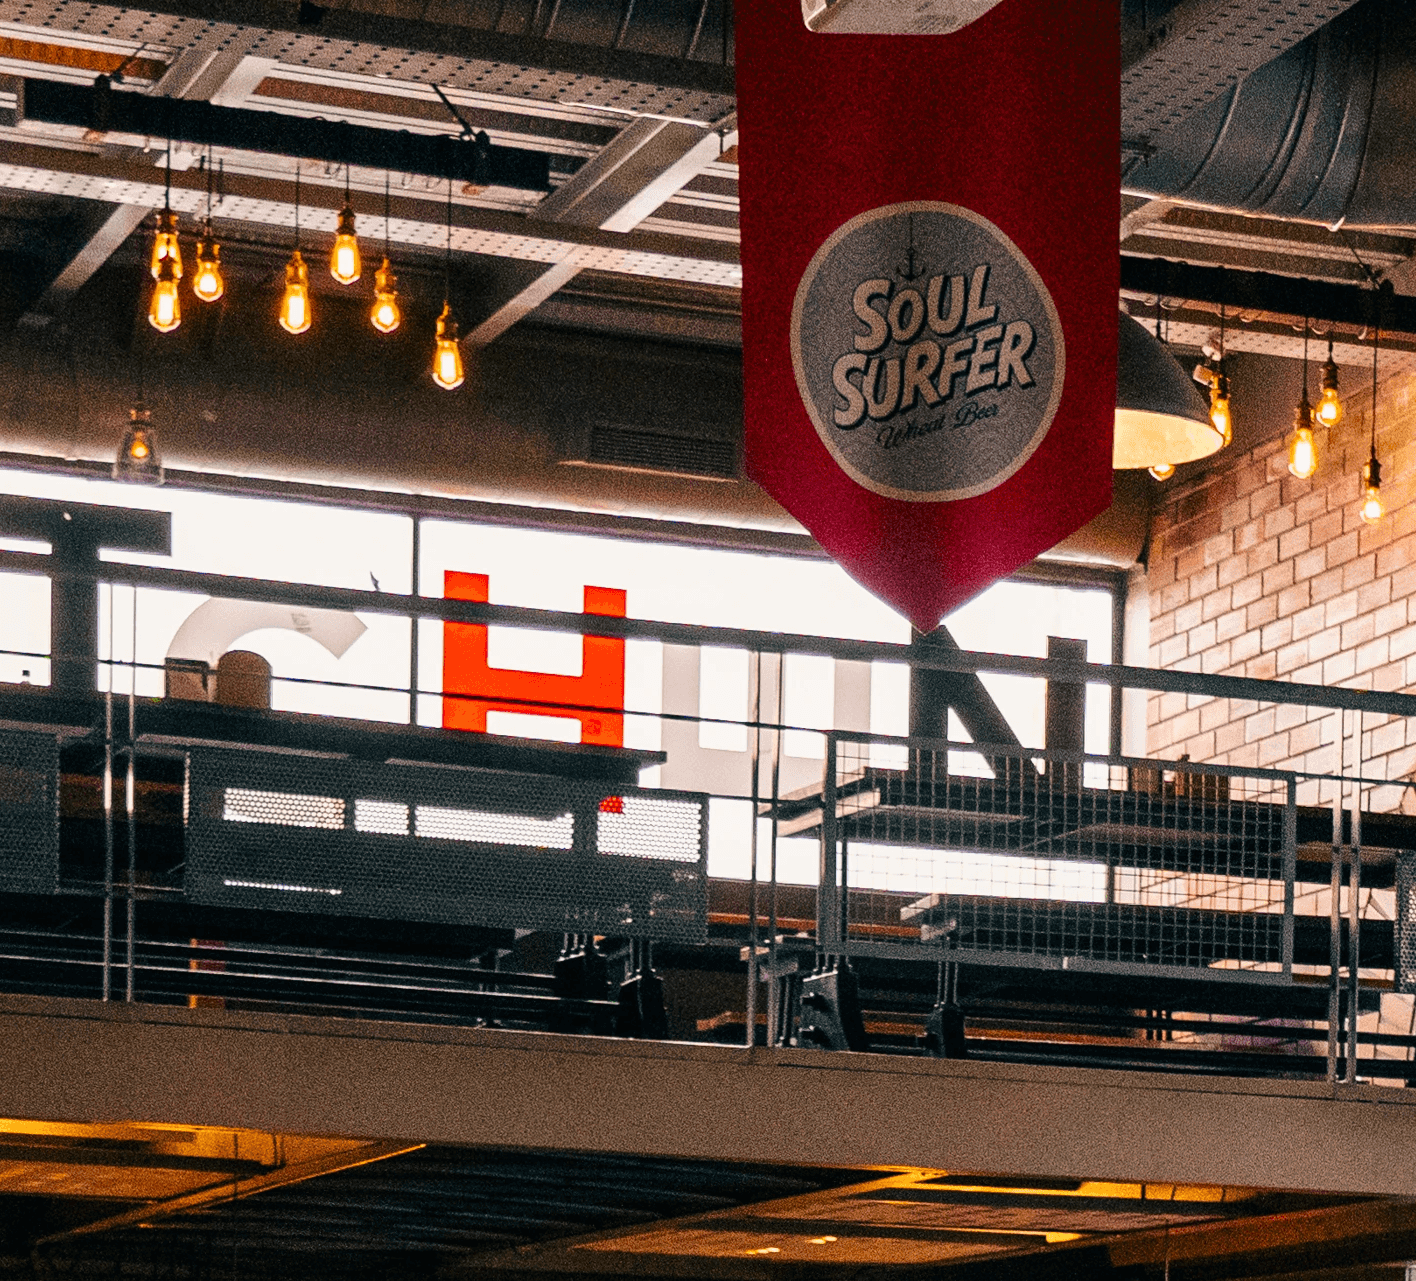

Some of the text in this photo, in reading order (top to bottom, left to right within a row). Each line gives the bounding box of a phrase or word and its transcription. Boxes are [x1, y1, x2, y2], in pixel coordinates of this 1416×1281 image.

[852, 264, 1000, 354] SOUL
[832, 320, 1037, 430] SURFER
[953, 401, 999, 429] Beer
